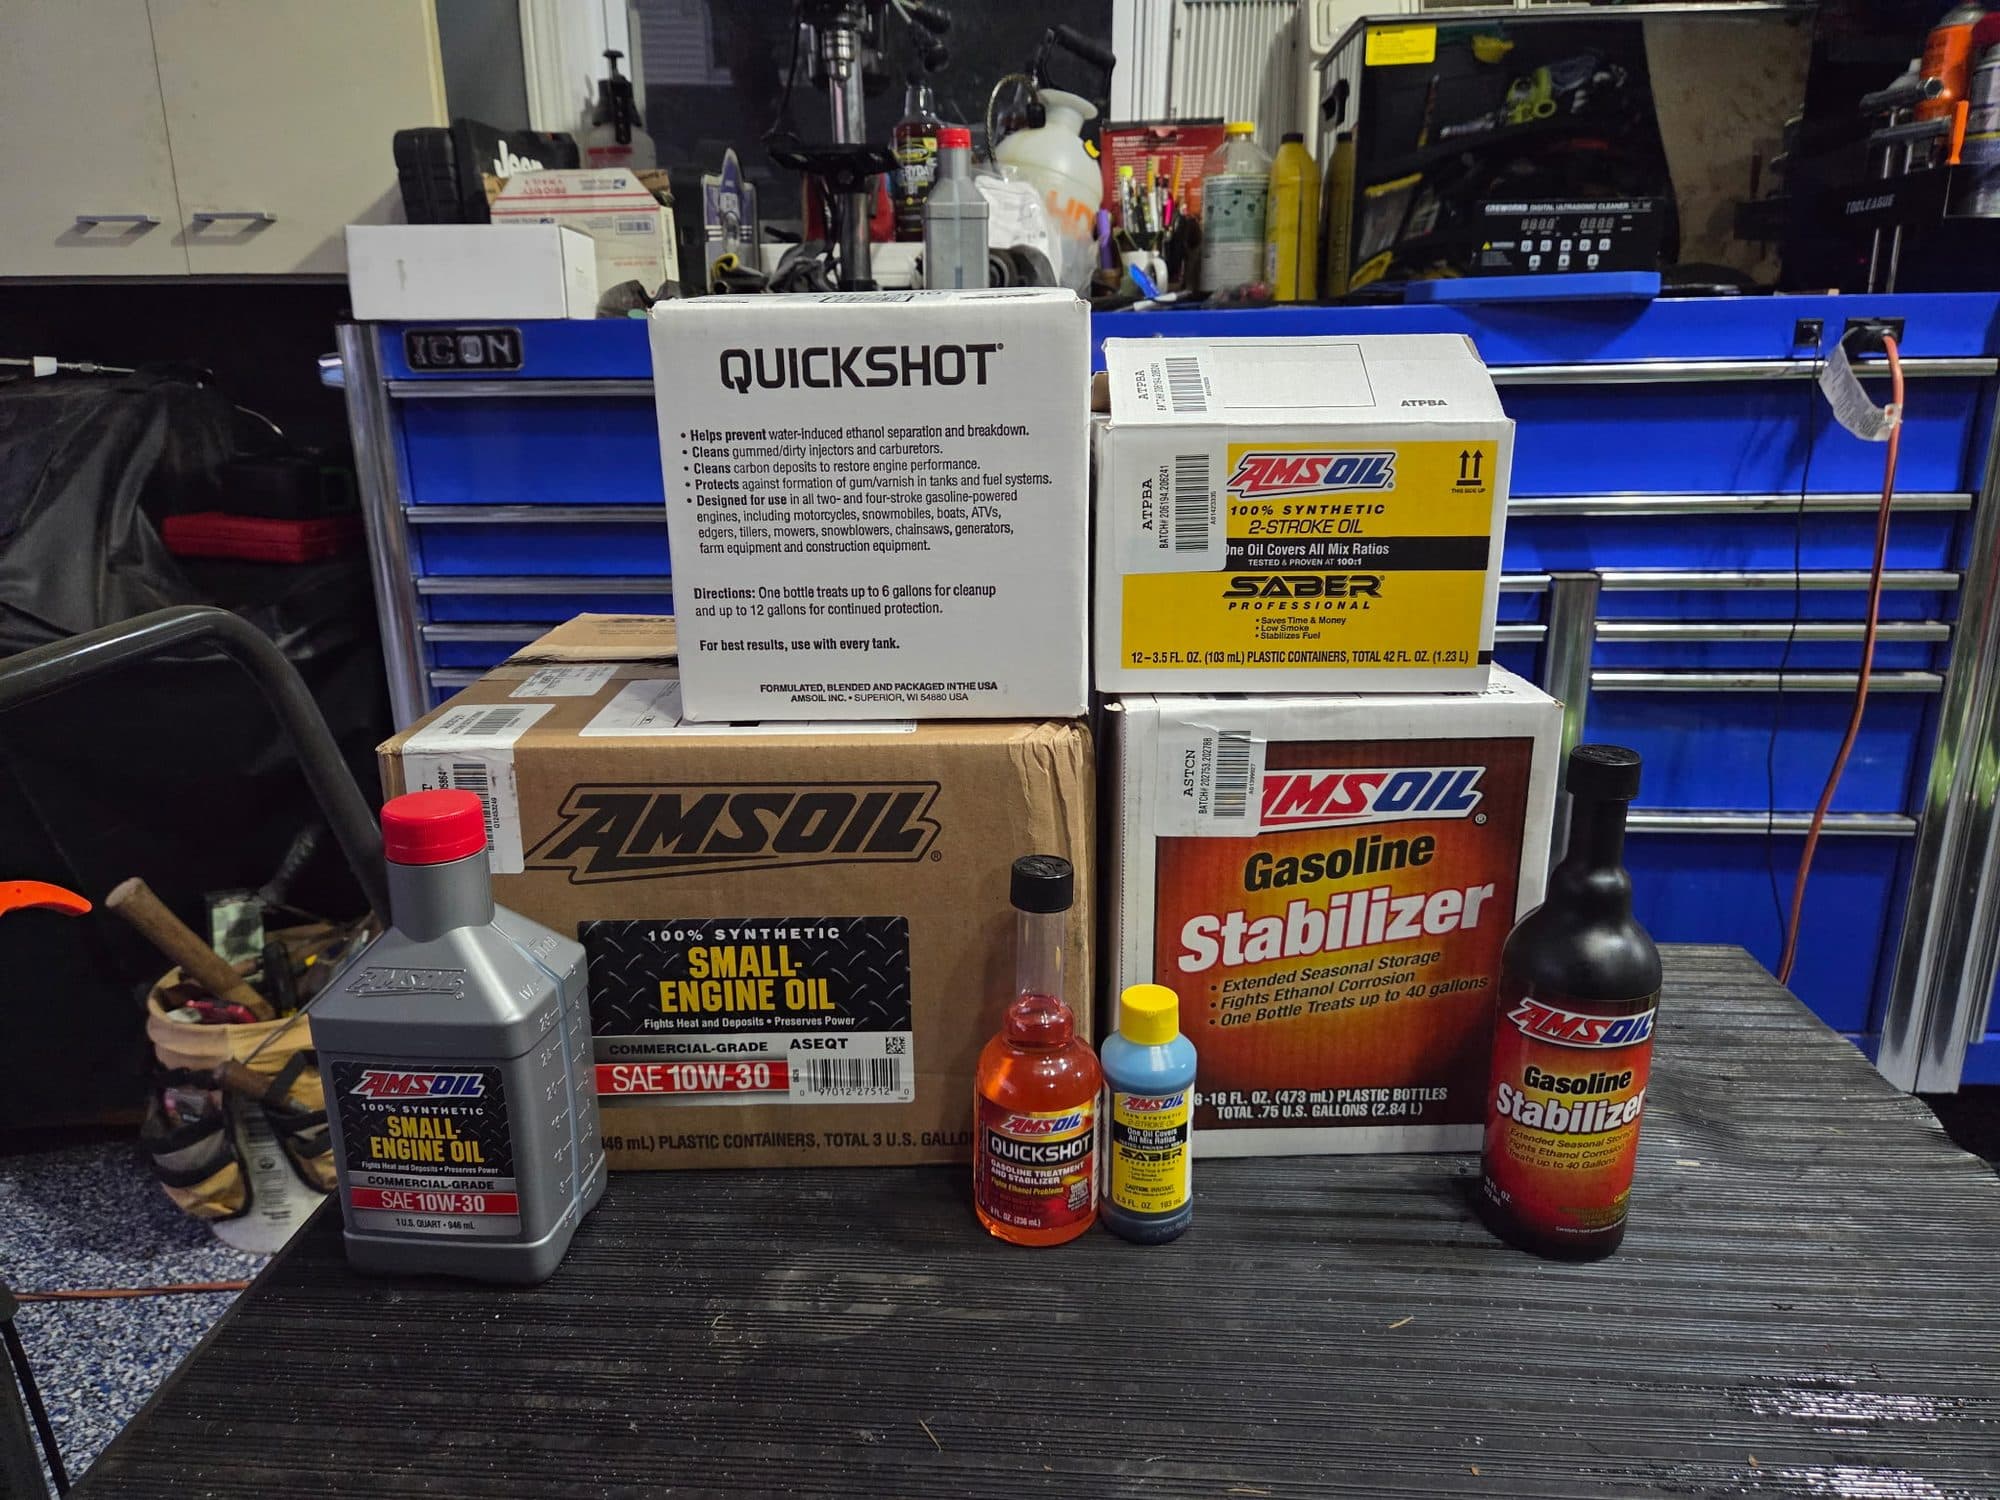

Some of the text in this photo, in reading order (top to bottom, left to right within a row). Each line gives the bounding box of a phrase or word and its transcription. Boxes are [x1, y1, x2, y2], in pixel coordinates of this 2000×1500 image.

[411, 334, 513, 364] ICON
[719, 343, 997, 394] QUICKSHOT
[1135, 369, 1149, 400] ATPBA
[690, 425, 1029, 444] Helps prevent water-induced ethanol separation and breakdown.
[692, 443, 943, 460] Cleans gummed/dirty injectors and carburetors.
[1229, 456, 1390, 492] AMSOIL
[1142, 478, 1153, 531] ATPBA
[1231, 504, 1385, 516] 100% SYNTHETIC
[1248, 519, 1363, 534] 2-STROKE OIL
[1247, 543, 1389, 555] Oil Covers All Mix Ratios
[1248, 558, 1280, 566] TESTED
[1289, 558, 1323, 566] PROVEN
[1337, 558, 1362, 566] 100:1
[694, 584, 996, 600] Directions: One bottle treats up to 6 gallons for cleanup
[1222, 575, 1383, 599] SABER
[1228, 601, 1371, 610] PROFESSIONAL
[1261, 617, 1346, 626] Saves Time Money
[1261, 624, 1309, 632] Low Smoke
[700, 637, 900, 652] For best results, use with every tank.
[1261, 632, 1300, 640] Stabilizes
[1247, 651, 1381, 664] PLASTIC CONTAINERS, TOTAL
[760, 682, 944, 692] FORMULATED, BLENDED AND PACKAGED
[791, 694, 826, 702] AMSOIL
[854, 694, 904, 702] SUPERIOR,
[920, 693, 947, 701] 54880
[949, 693, 968, 701] USA
[1183, 750, 1195, 797] ASTCN
[545, 791, 929, 873] AMSOIL
[1244, 834, 1435, 891] Gasoline
[647, 927, 840, 942] 100% SYNTHETIC
[1177, 883, 1495, 973] Stabilizer
[688, 944, 803, 979] SMALL-
[1222, 951, 1440, 993] Extended Seasonal Storage
[659, 978, 836, 1013] ENGINE OIL
[1220, 970, 1415, 1011] Fights Ethanol Corrosion
[1220, 976, 1488, 1026] One Bottle Treats gallons
[644, 1016, 855, 1029] Fights Heat and Deposits Preserves Power
[1514, 1003, 1653, 1044] AMSOIL
[609, 1041, 769, 1055] COMMERCIAL-GRADE
[789, 1038, 848, 1050] ASEQT
[354, 1071, 484, 1098] AMSOIL
[612, 1066, 663, 1091] SAE
[666, 1063, 770, 1091] 10W-30
[1523, 1066, 1632, 1095] Gasoline
[857, 1087, 890, 1096] 27512
[1338, 1087, 1447, 1102] PLASTIC BOTTLES
[361, 1103, 484, 1115] 100% SYNTHETIC
[1122, 1094, 1184, 1111] AMSOIL
[1217, 1104, 1368, 1119] TOTAL U.S. GALLONS
[1496, 1083, 1647, 1134] Stabilizer
[386, 1116, 461, 1139] SMALL-
[1003, 1113, 1081, 1135] AMSOIL
[659, 1132, 869, 1149] PLASTIC CONTAINERS, TOTAL
[1510, 1128, 1604, 1148] Extended Seasonal
[370, 1137, 485, 1163] ENGINE OIL
[991, 1134, 1091, 1163] QUICKSHOT
[1119, 1147, 1182, 1161] SABER
[1509, 1138, 1579, 1159] Fights Ethanol
[991, 1159, 1085, 1178] GASOLINE TREATMENT
[1566, 1161, 1579, 1169] 40
[1582, 1157, 1616, 1169] Gallons
[368, 1176, 494, 1190] COMMERCIAL-GRADE
[1008, 1174, 1060, 1185] STABILIZER
[381, 1191, 485, 1212] SAE 10W-30
[416, 1220, 441, 1229] QUART
